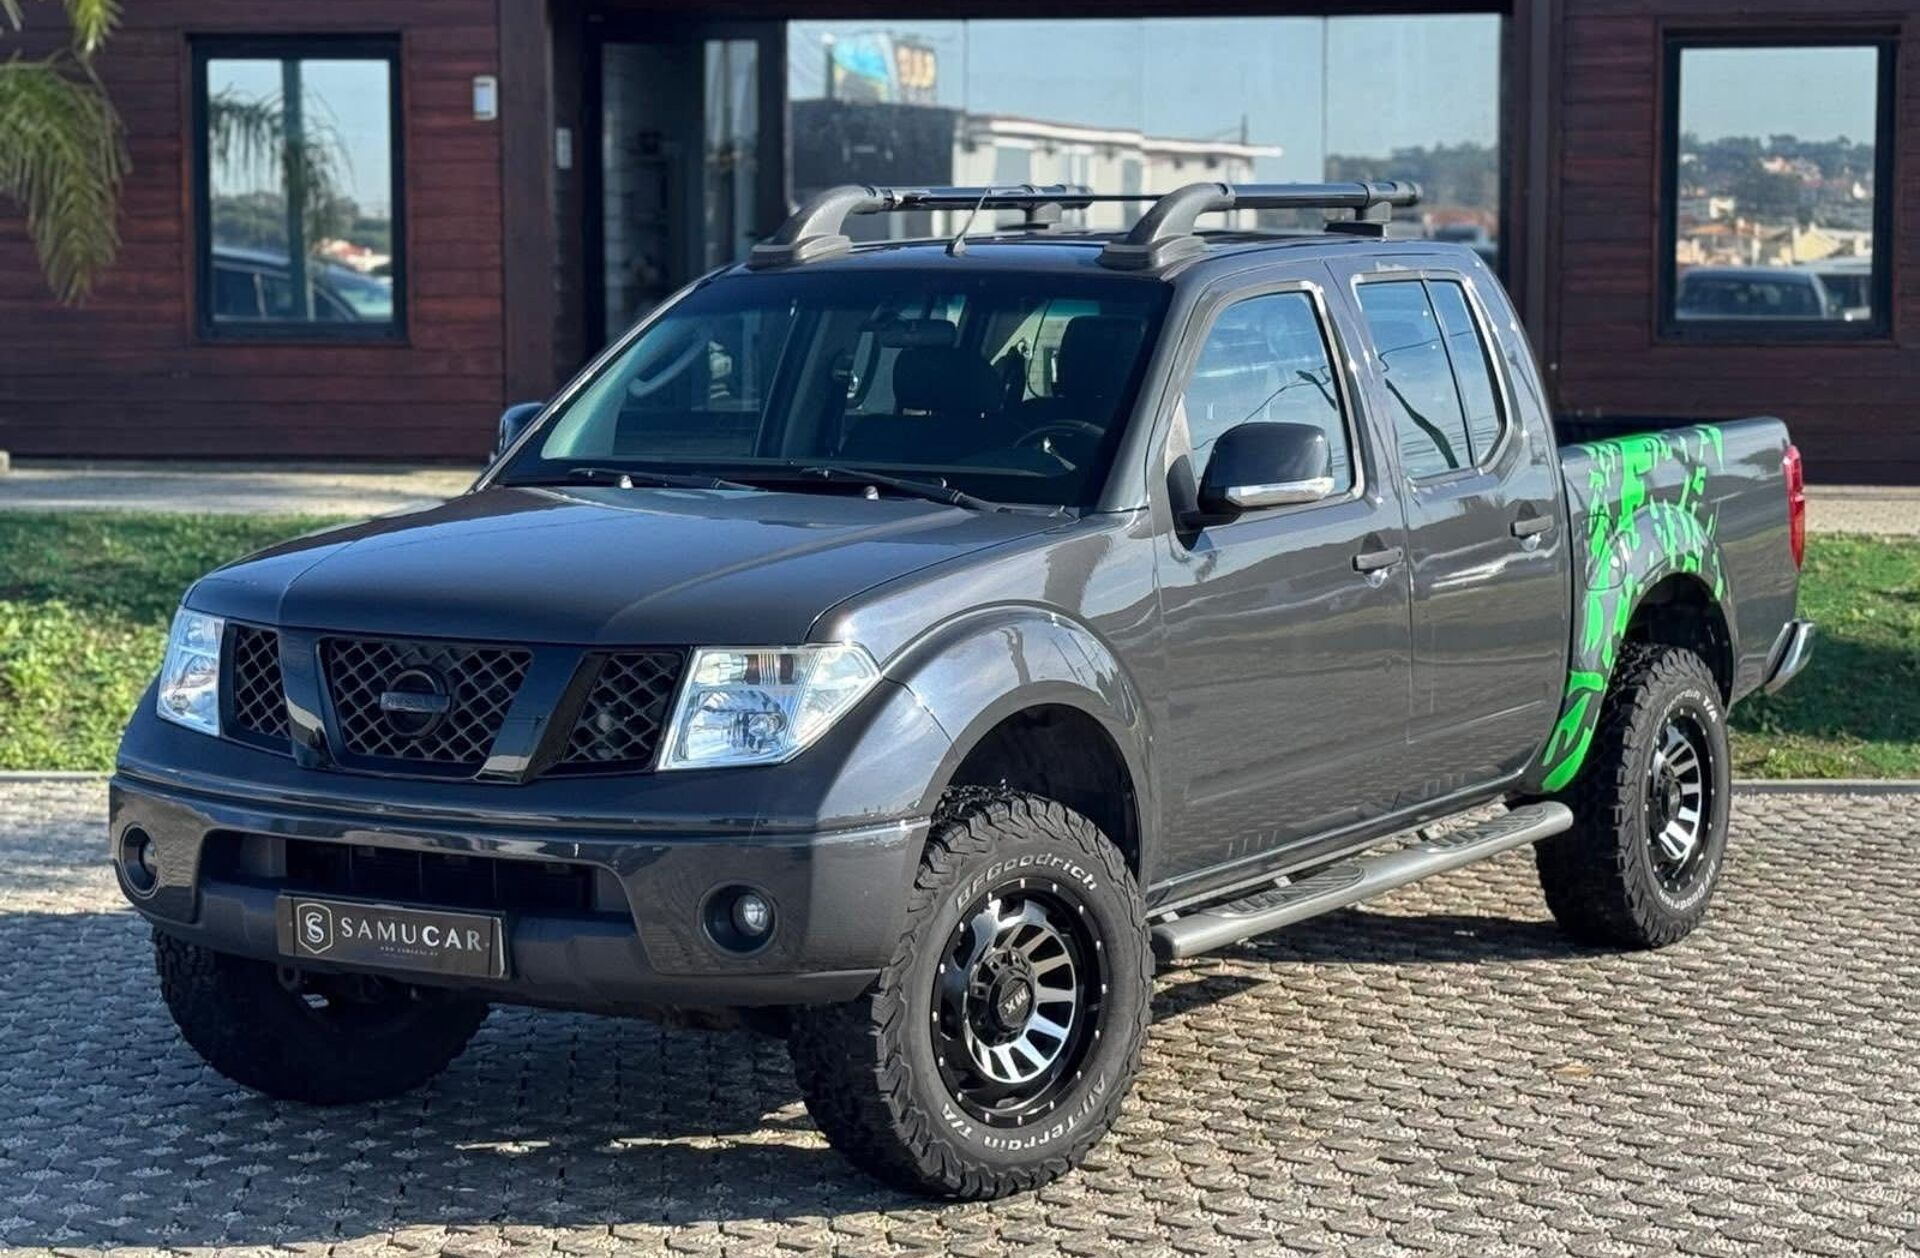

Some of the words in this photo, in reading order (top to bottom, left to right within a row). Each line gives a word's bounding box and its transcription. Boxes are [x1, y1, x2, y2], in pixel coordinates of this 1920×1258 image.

[956, 851, 1099, 912] BFGoodrich
[340, 916, 483, 952] SAMUCAR
[938, 1102, 974, 1143] T/A
[984, 1070, 1108, 1153] All-Terrain
